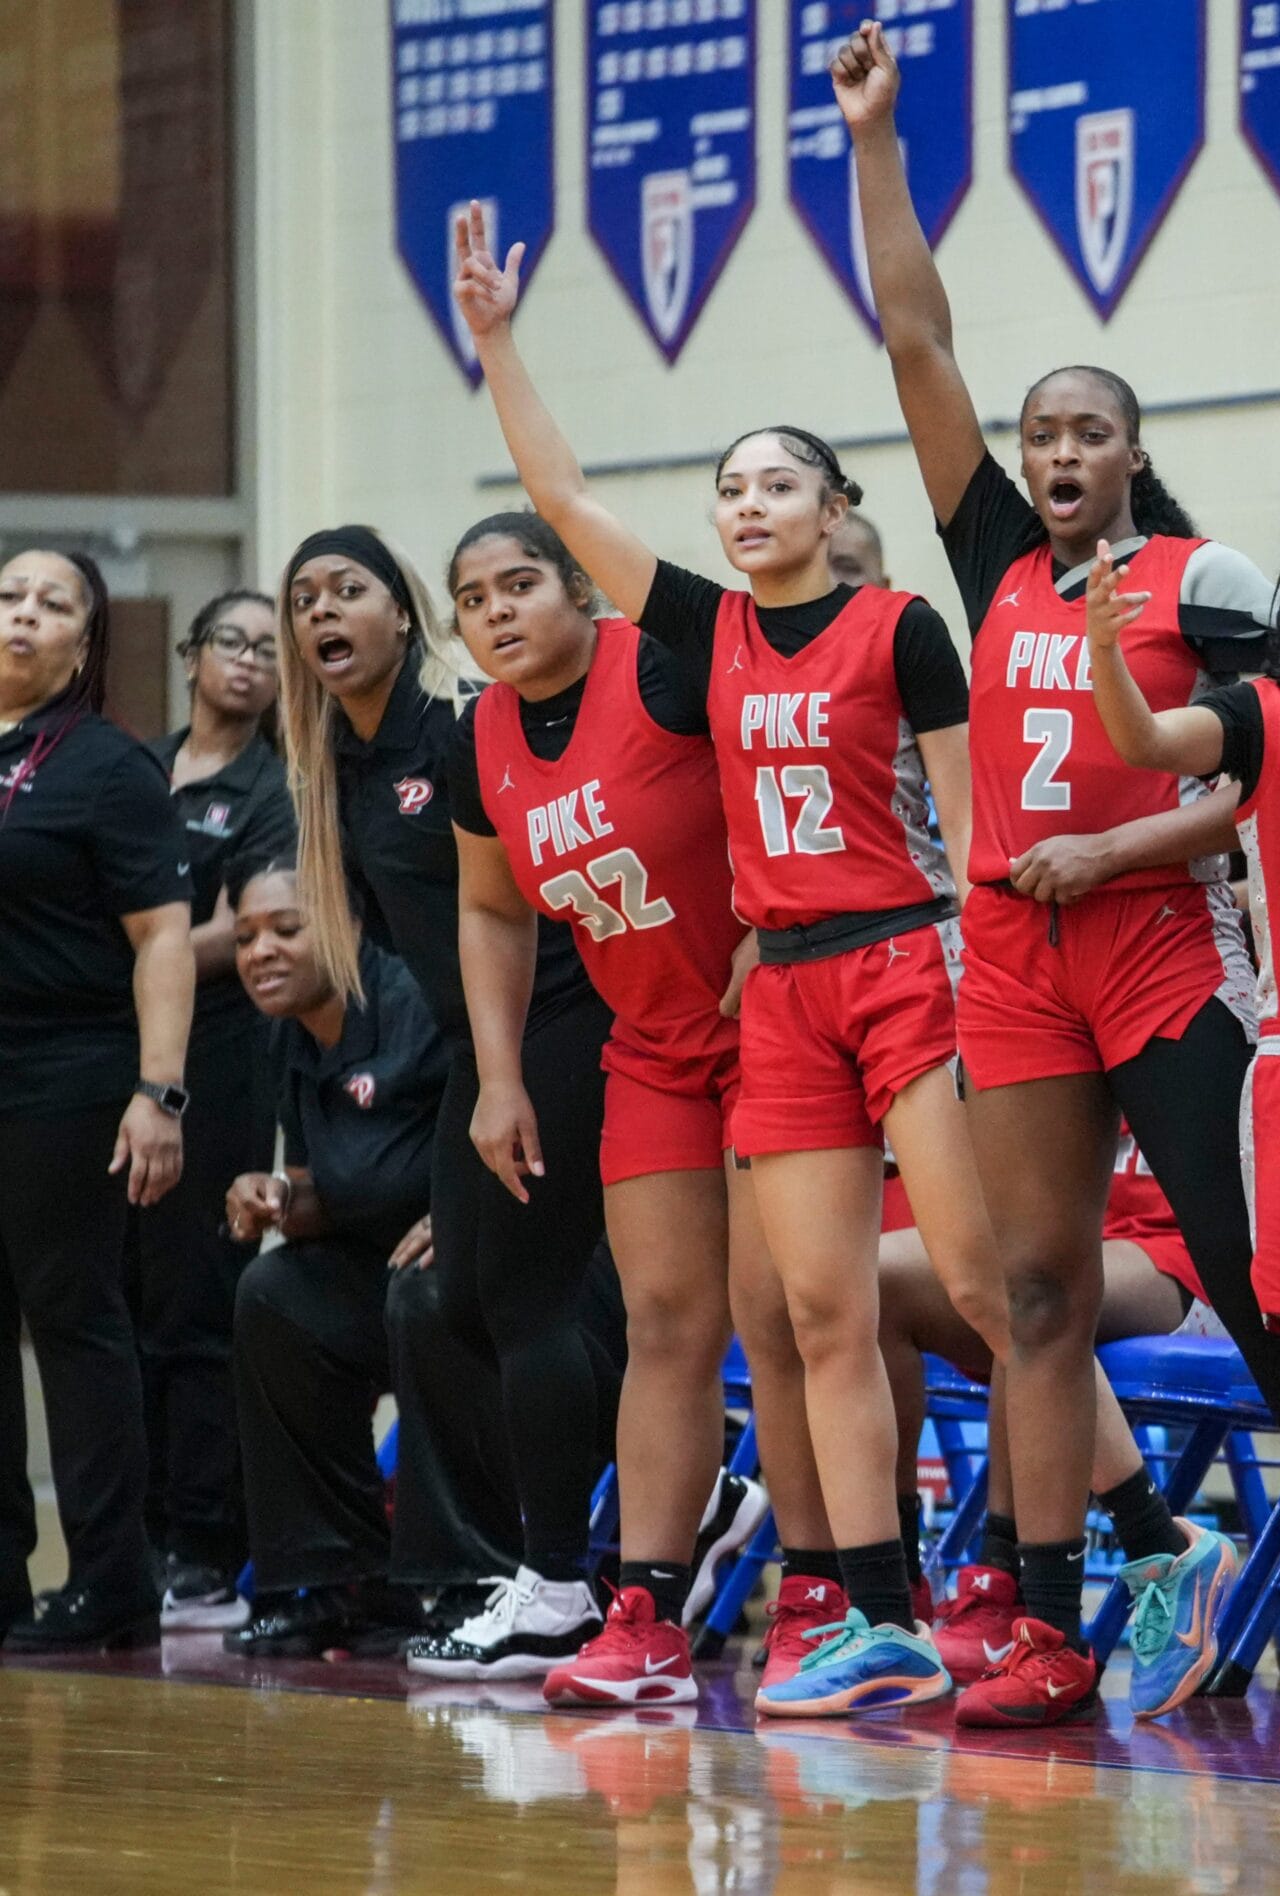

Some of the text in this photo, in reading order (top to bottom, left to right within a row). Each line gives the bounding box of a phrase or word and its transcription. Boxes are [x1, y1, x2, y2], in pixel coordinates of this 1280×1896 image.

[1006, 631, 1095, 690] PIKE
[740, 692, 831, 750] PIKE
[395, 777, 433, 812] P
[1021, 707, 1073, 811] 2
[526, 778, 615, 867] PIKE
[754, 764, 848, 858] 12
[539, 847, 676, 942] 32
[346, 1072, 375, 1107] P
